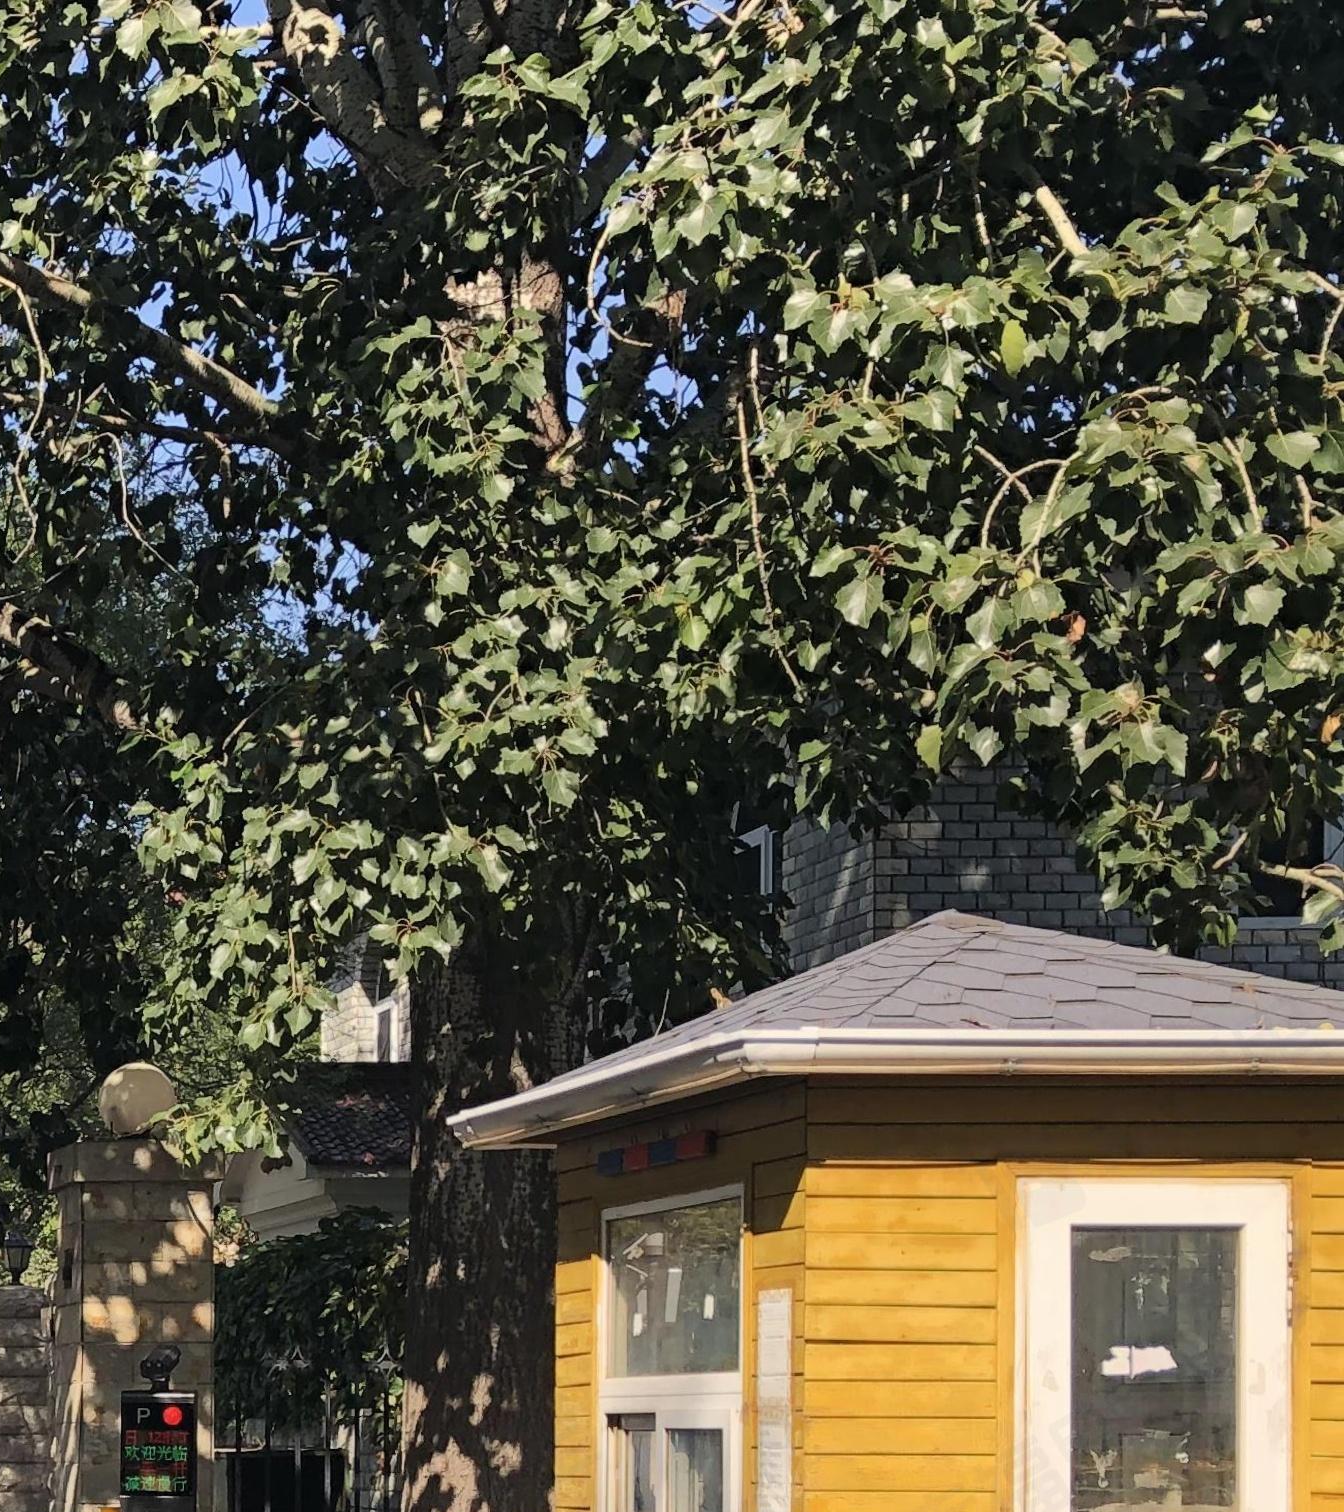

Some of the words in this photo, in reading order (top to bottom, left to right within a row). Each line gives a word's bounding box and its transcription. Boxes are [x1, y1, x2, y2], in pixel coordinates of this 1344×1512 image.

[137, 1407, 151, 1424] P
[124, 1445, 188, 1461] 欢迎光临
